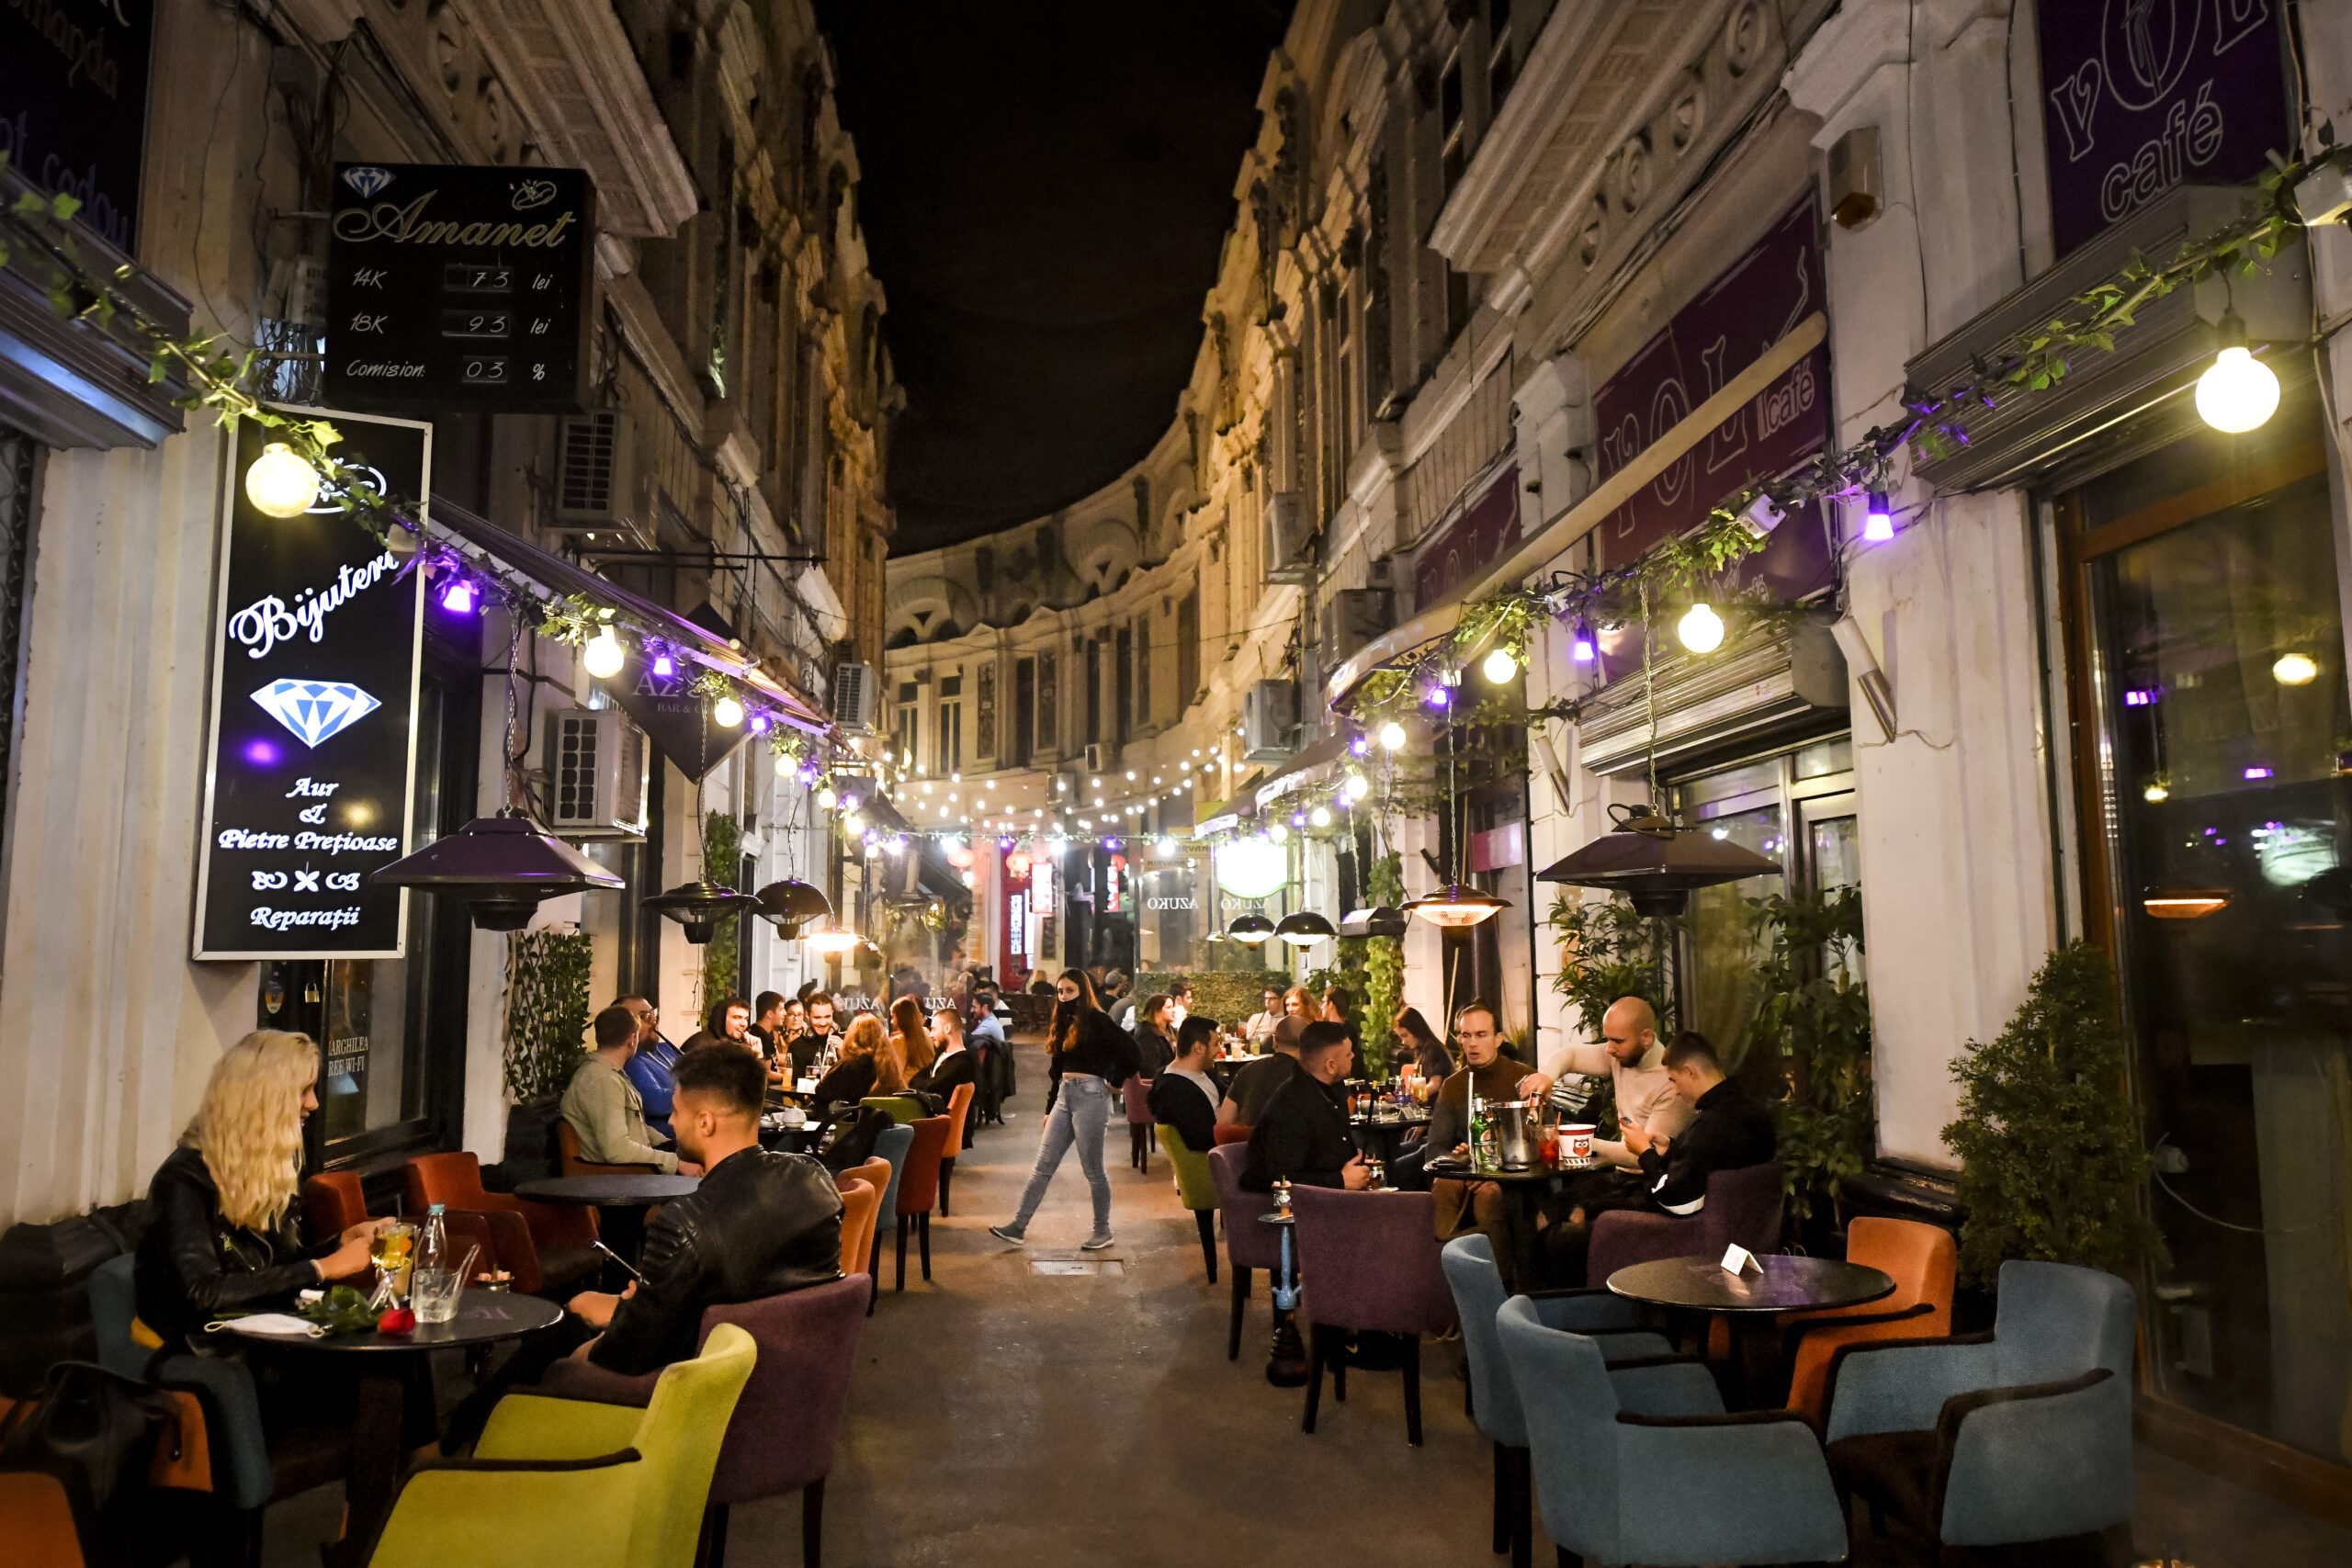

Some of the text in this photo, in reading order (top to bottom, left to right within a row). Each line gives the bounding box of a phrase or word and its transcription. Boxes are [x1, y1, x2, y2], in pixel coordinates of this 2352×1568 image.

[2101, 78, 2223, 222] café
[333, 189, 576, 248] Amanet
[353, 266, 387, 289] 14K
[532, 274, 552, 289] lei
[350, 312, 388, 334] 18K
[530, 319, 550, 334] lei
[346, 359, 425, 378] Comision:
[533, 364, 545, 380] %
[1766, 356, 1815, 435] café
[229, 551, 399, 659] Bijuteri
[657, 703, 679, 713] BAR
[285, 777, 339, 797] Aur
[299, 804, 327, 824] &
[218, 829, 290, 850] Pietre
[328, 1055, 365, 1077] REE WI-FI
